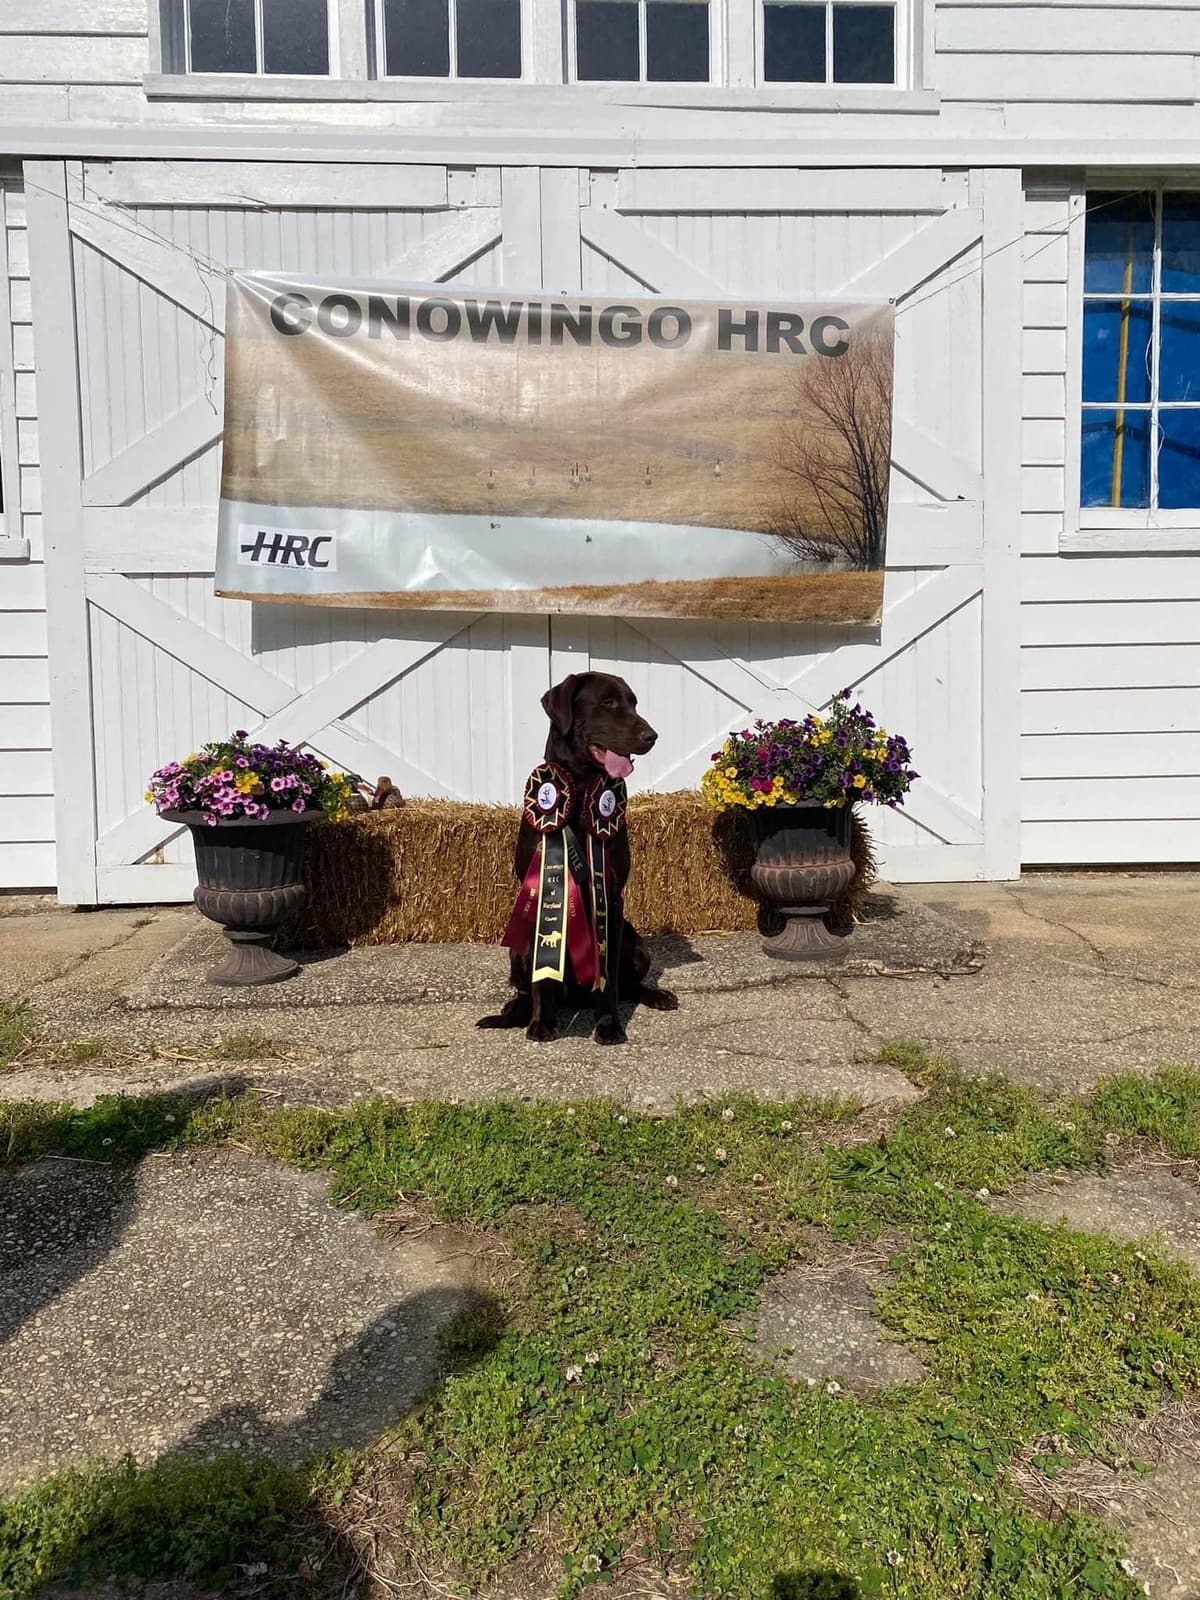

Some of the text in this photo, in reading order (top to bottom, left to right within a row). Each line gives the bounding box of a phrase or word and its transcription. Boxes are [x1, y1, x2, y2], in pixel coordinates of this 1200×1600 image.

[270, 292, 850, 358] CONOWINGO HRC
[241, 531, 332, 567] HRC
